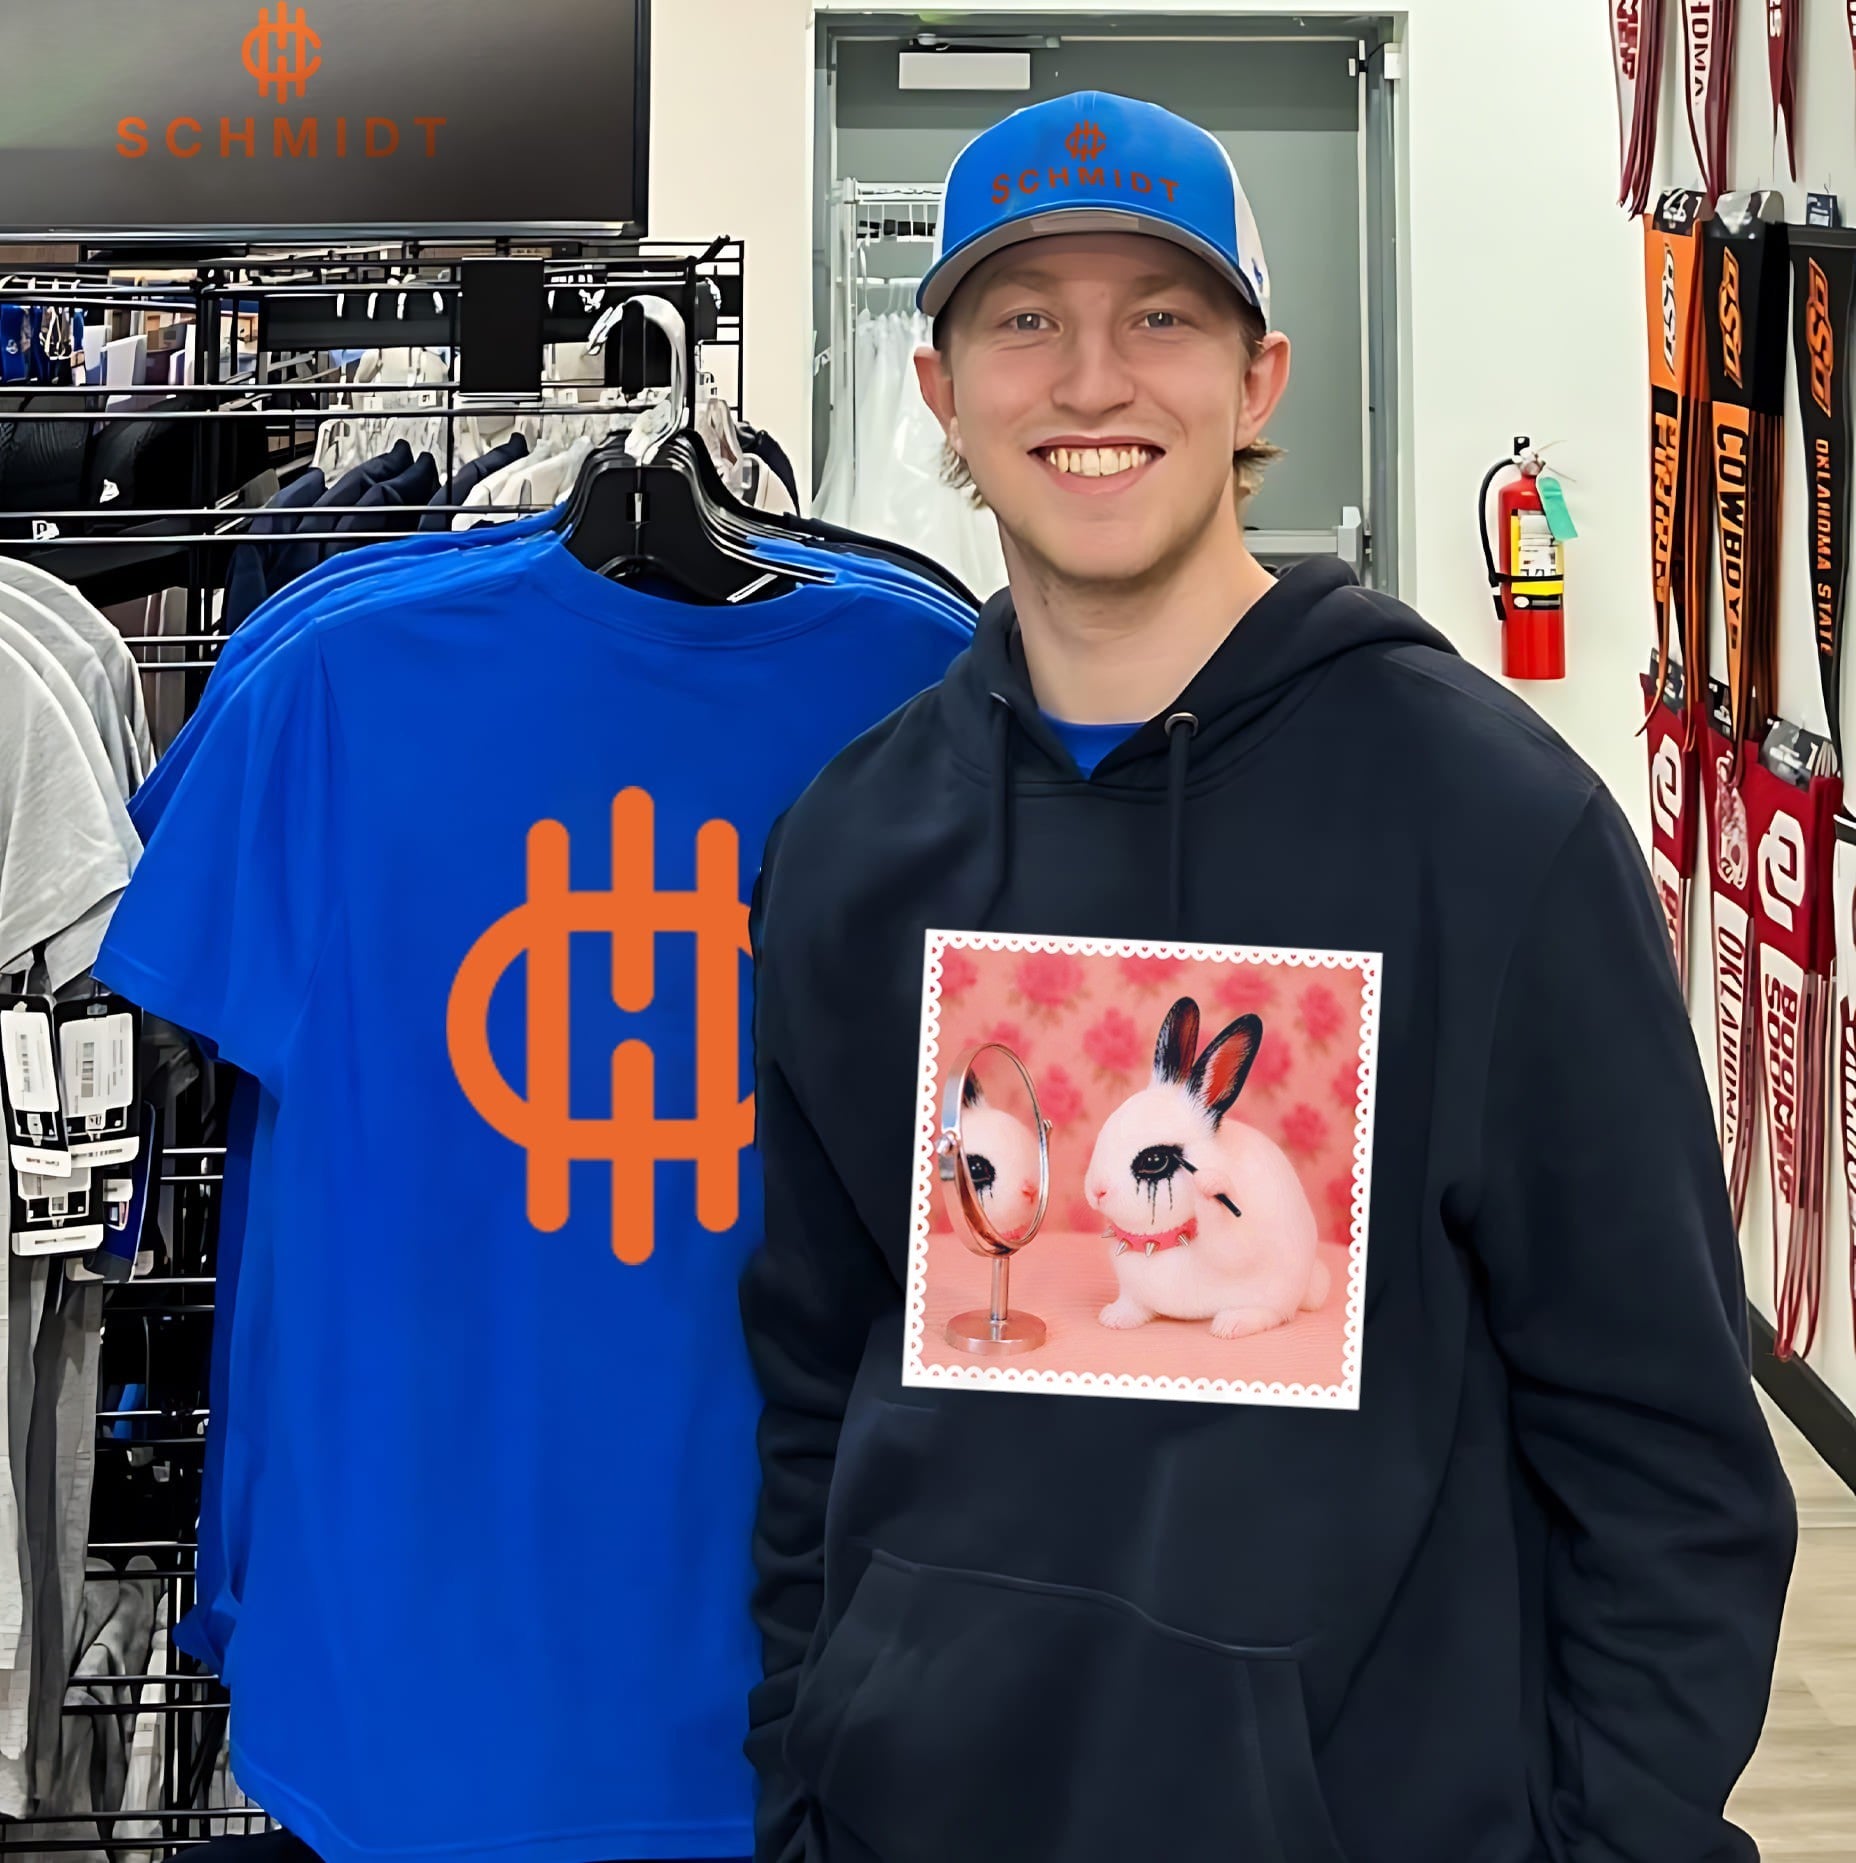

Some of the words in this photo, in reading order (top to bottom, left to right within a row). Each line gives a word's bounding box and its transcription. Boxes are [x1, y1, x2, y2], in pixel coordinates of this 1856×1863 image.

[115, 117, 447, 158] SCHMIDT
[992, 167, 1179, 204] SCHMIDT
[1815, 438, 1831, 570] OKLAHOMA
[1718, 924, 1745, 1143] OKLAHOMA
